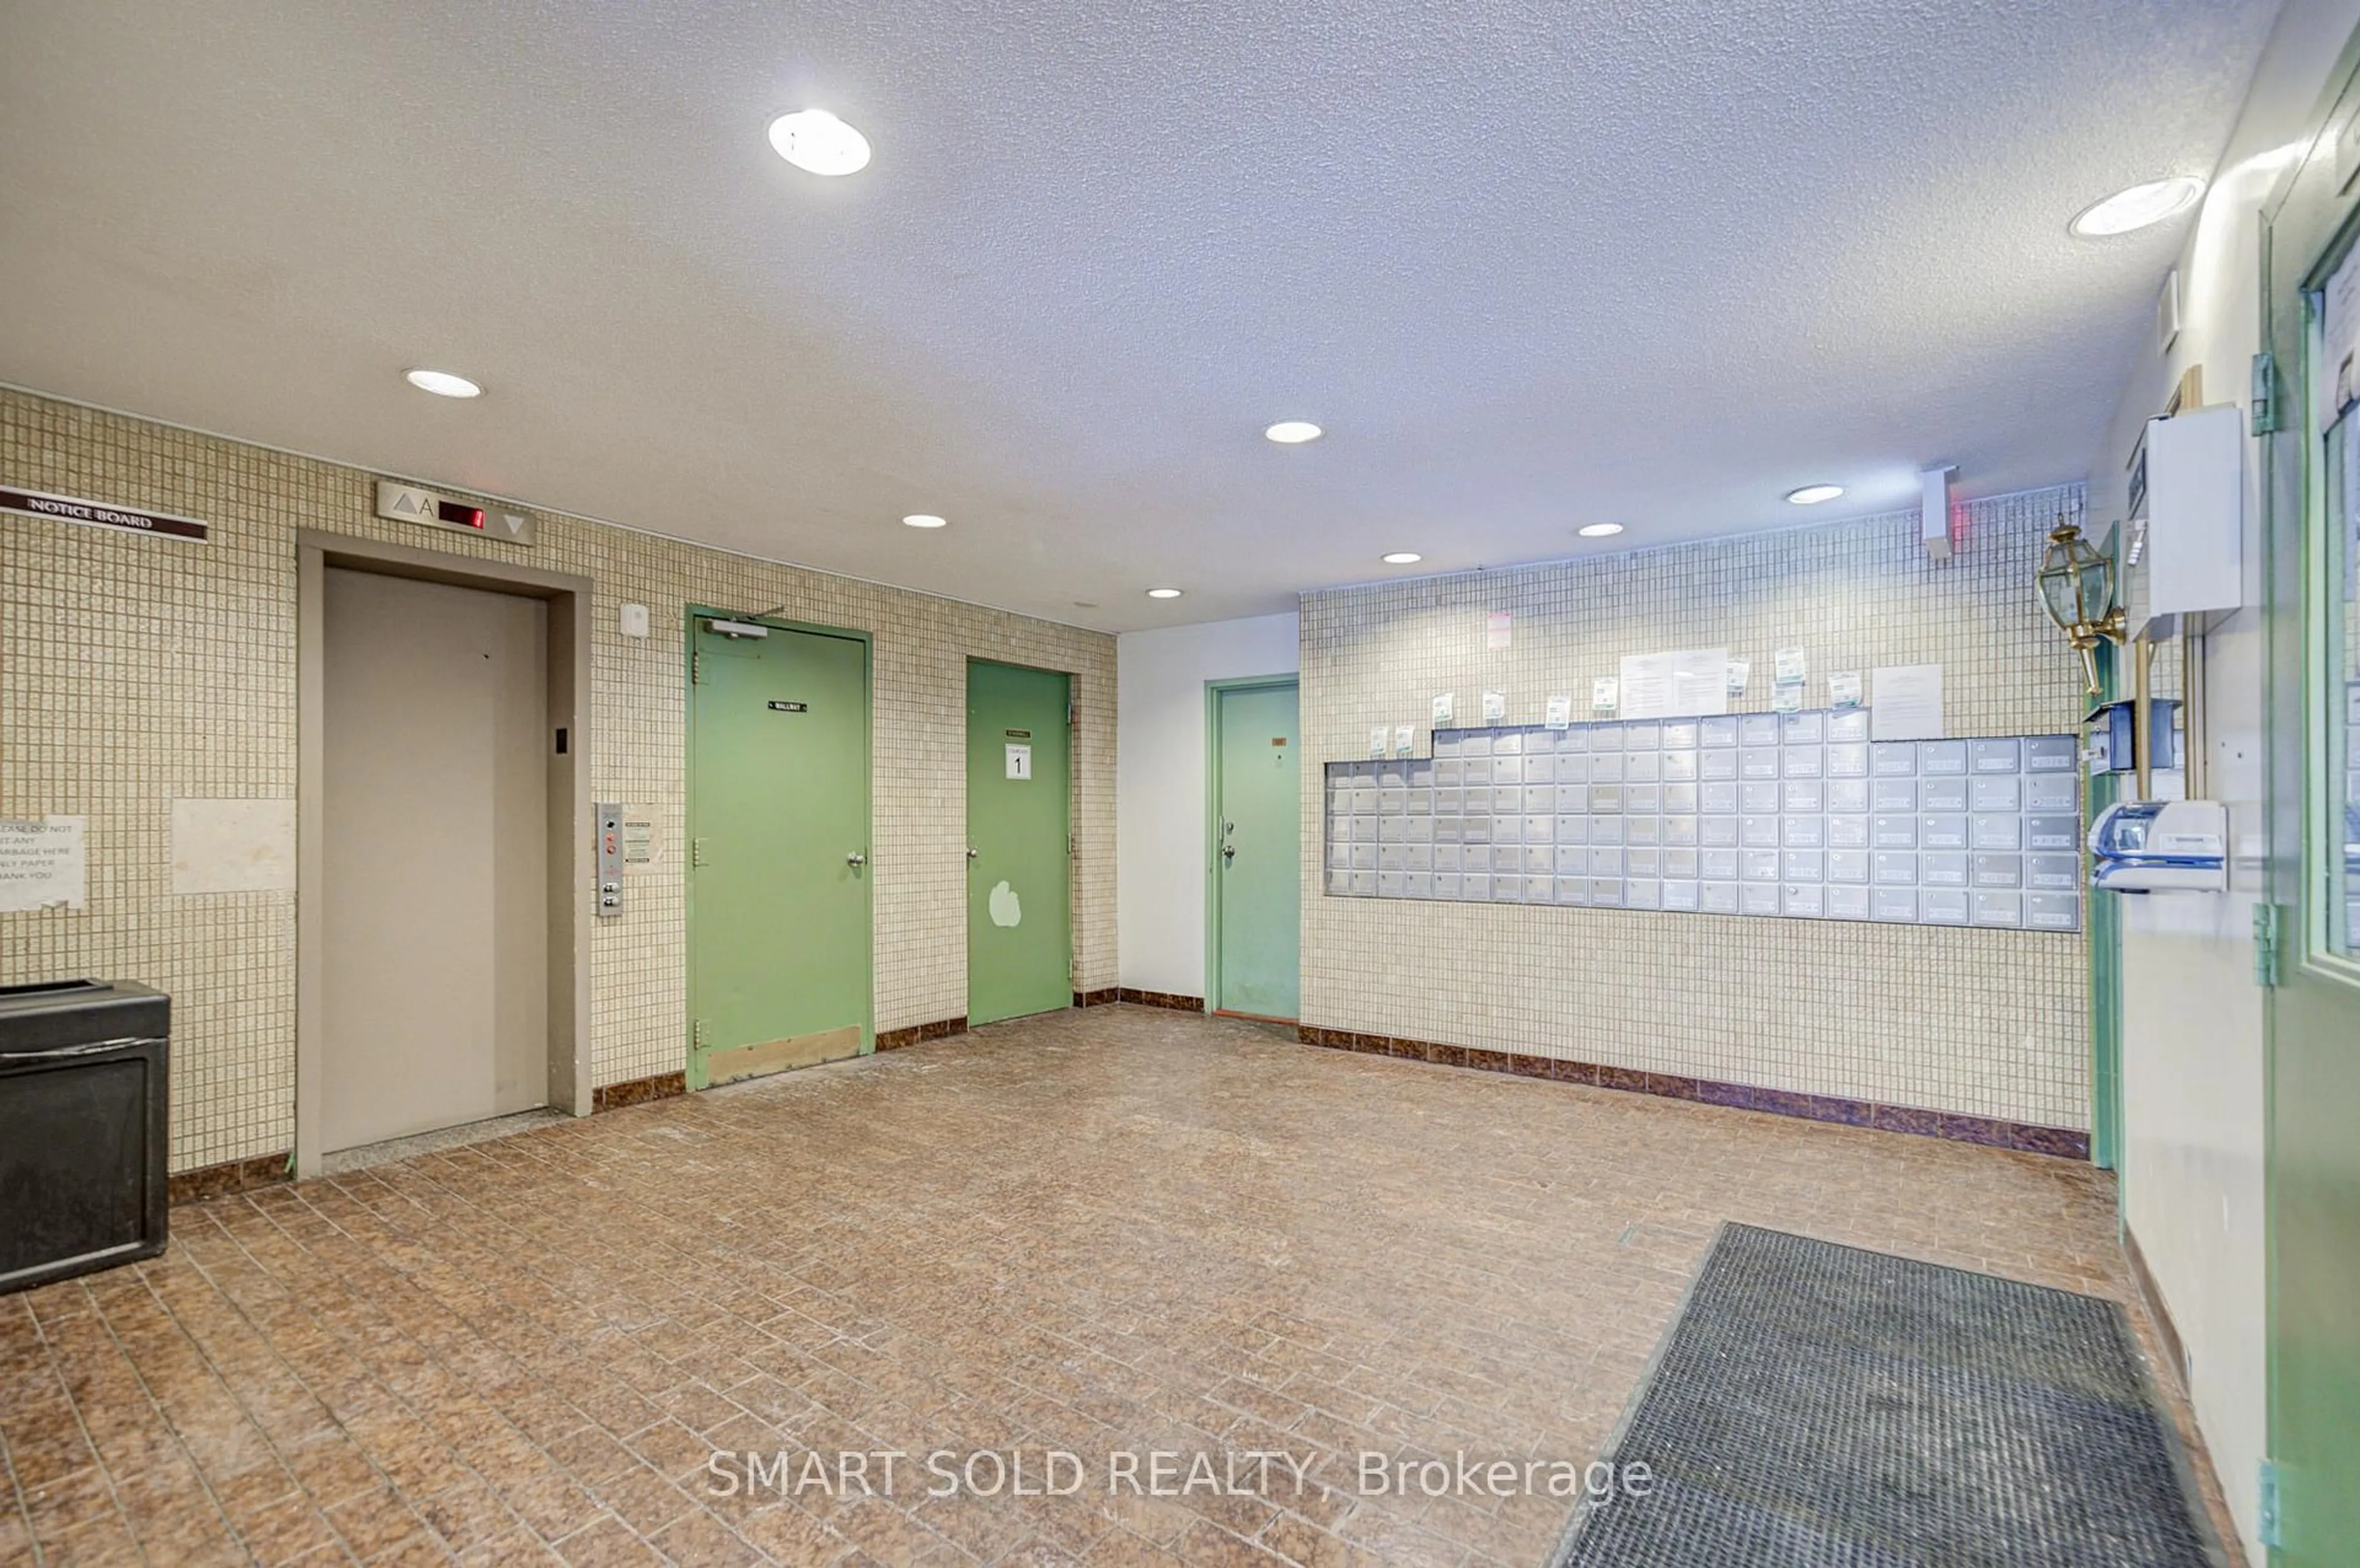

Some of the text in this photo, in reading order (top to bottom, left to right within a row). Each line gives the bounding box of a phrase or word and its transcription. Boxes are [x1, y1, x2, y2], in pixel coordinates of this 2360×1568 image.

[28, 498, 152, 528] NOTICE BOARD
[419, 498, 434, 517] A
[1014, 756, 1021, 774] 1
